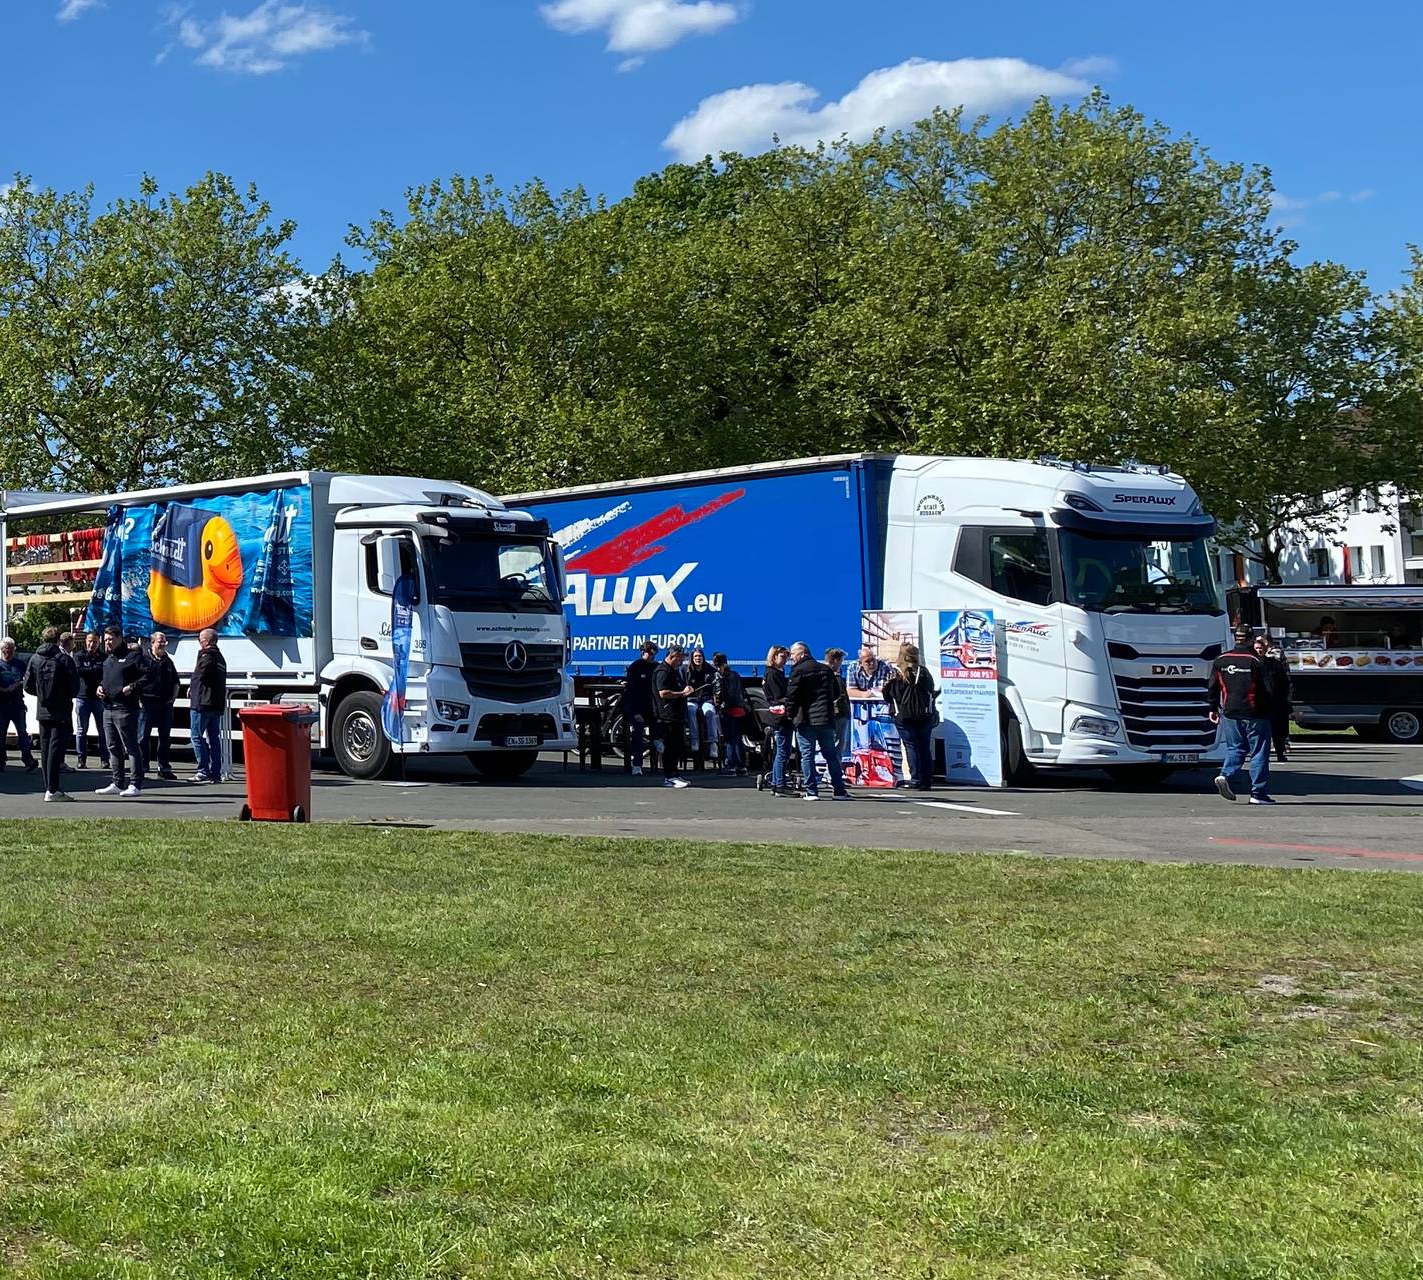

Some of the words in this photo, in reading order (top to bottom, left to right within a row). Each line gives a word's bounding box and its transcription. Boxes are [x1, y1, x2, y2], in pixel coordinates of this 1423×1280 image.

[573, 635, 629, 651] PARTNER
[632, 635, 646, 649] IN
[649, 633, 704, 650] EUROPA
[1151, 664, 1194, 675] DAF
